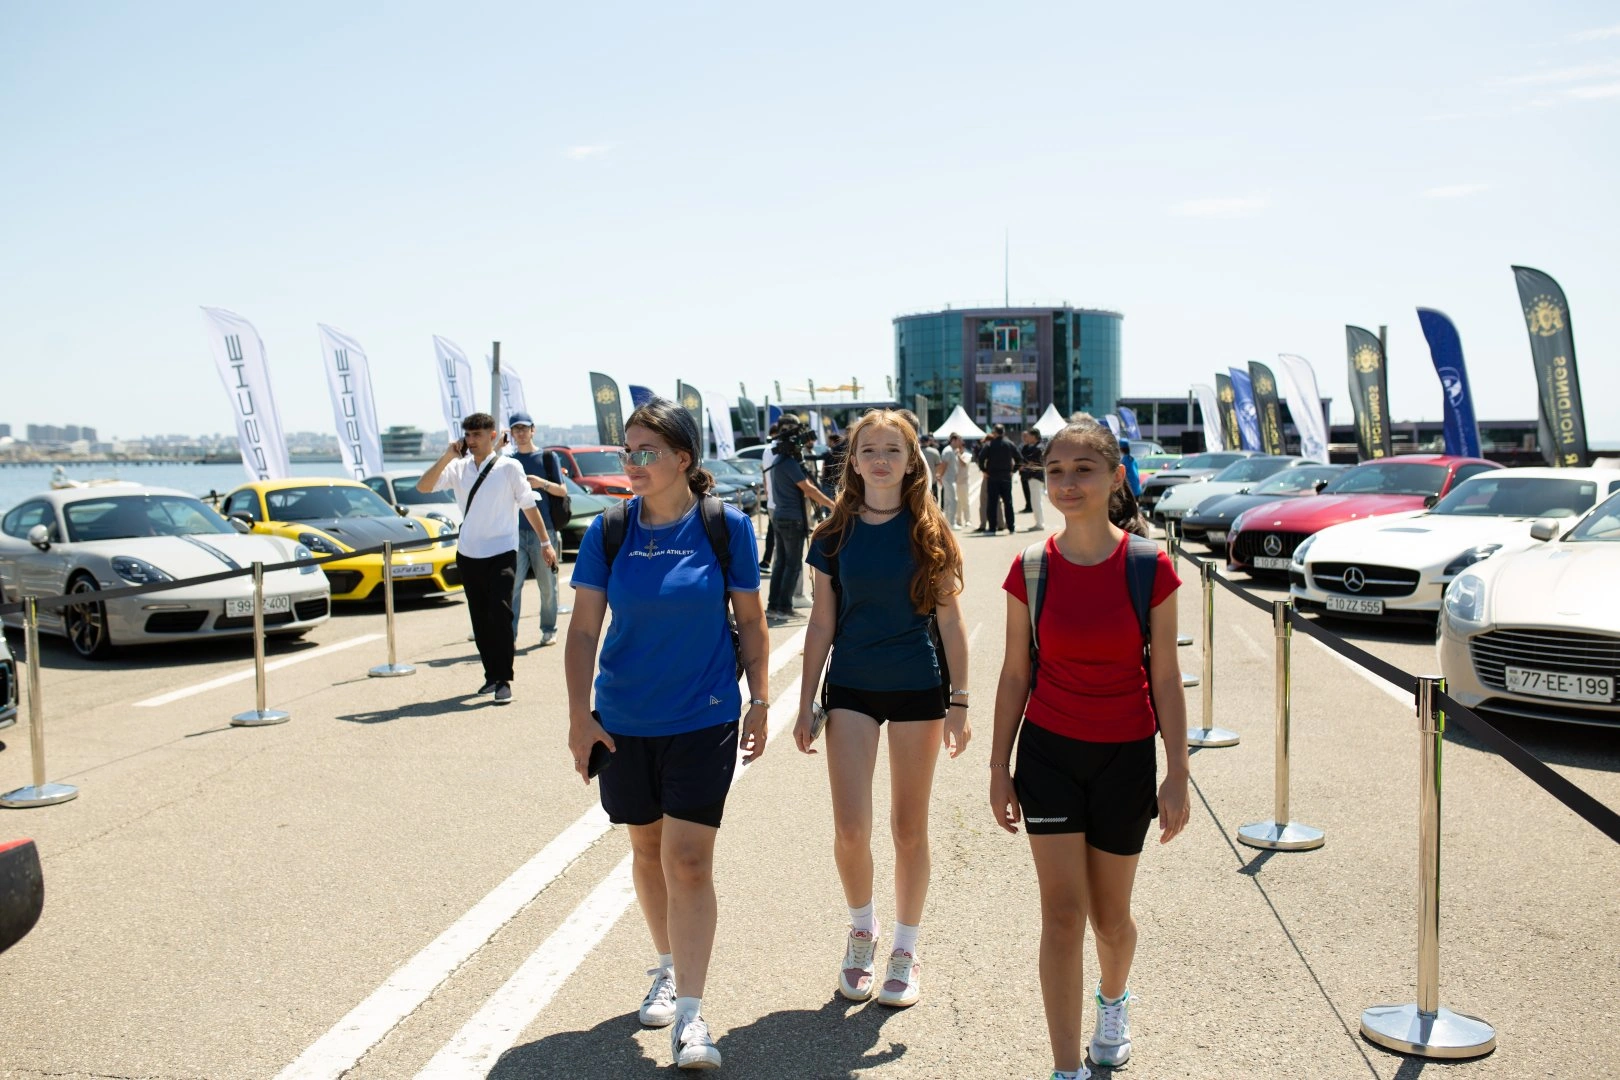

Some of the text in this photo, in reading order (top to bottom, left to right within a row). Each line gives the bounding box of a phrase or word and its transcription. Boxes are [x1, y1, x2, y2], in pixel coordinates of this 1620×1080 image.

[1336, 599, 1344, 610] 10
[1360, 600, 1380, 613] 555
[1521, 670, 1609, 696] 77-EE-199
